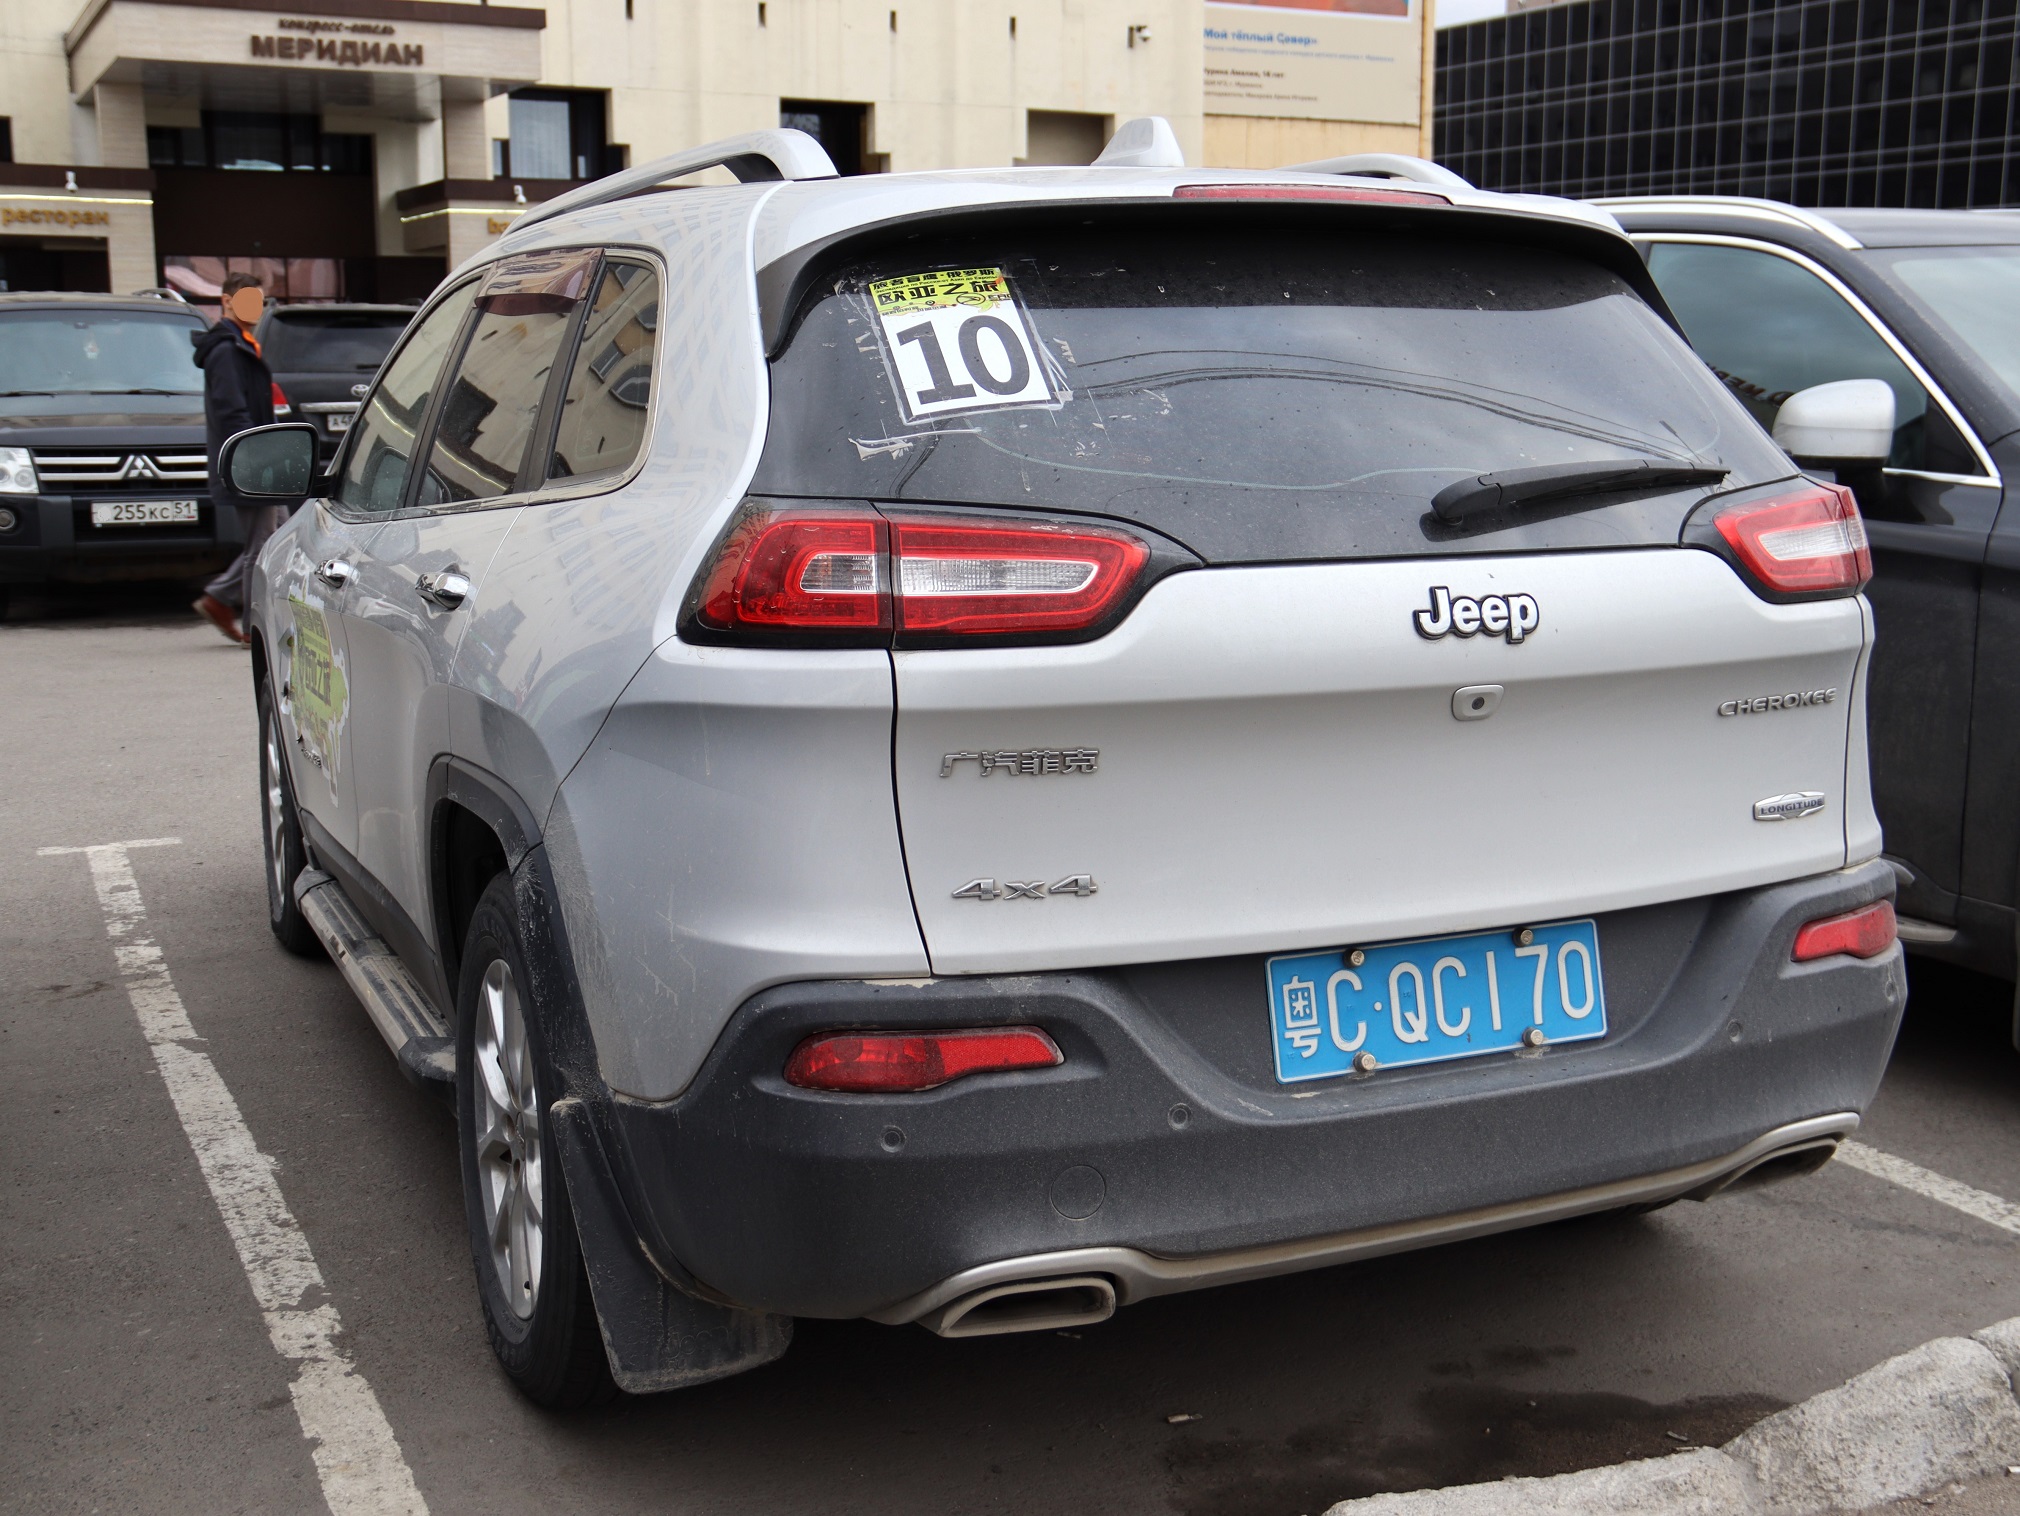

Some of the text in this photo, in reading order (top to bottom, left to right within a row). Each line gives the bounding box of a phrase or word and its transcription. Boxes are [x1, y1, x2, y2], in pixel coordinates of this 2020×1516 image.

[1203, 28, 1228, 40] Мой
[1231, 30, 1274, 43] тёплый
[251, 35, 424, 66] МЕРИДИАН
[2, 207, 110, 229] ресторан
[878, 280, 1000, 306] 欧亚之旅
[896, 315, 1030, 405] 10
[174, 501, 192, 515] 51
[1412, 586, 1540, 644] Jeep
[1717, 687, 1837, 717] CHEROKEE
[939, 748, 1100, 778] 广汽菲克
[1760, 798, 1823, 815] LONGITUDE
[951, 873, 1098, 901] 4x4
